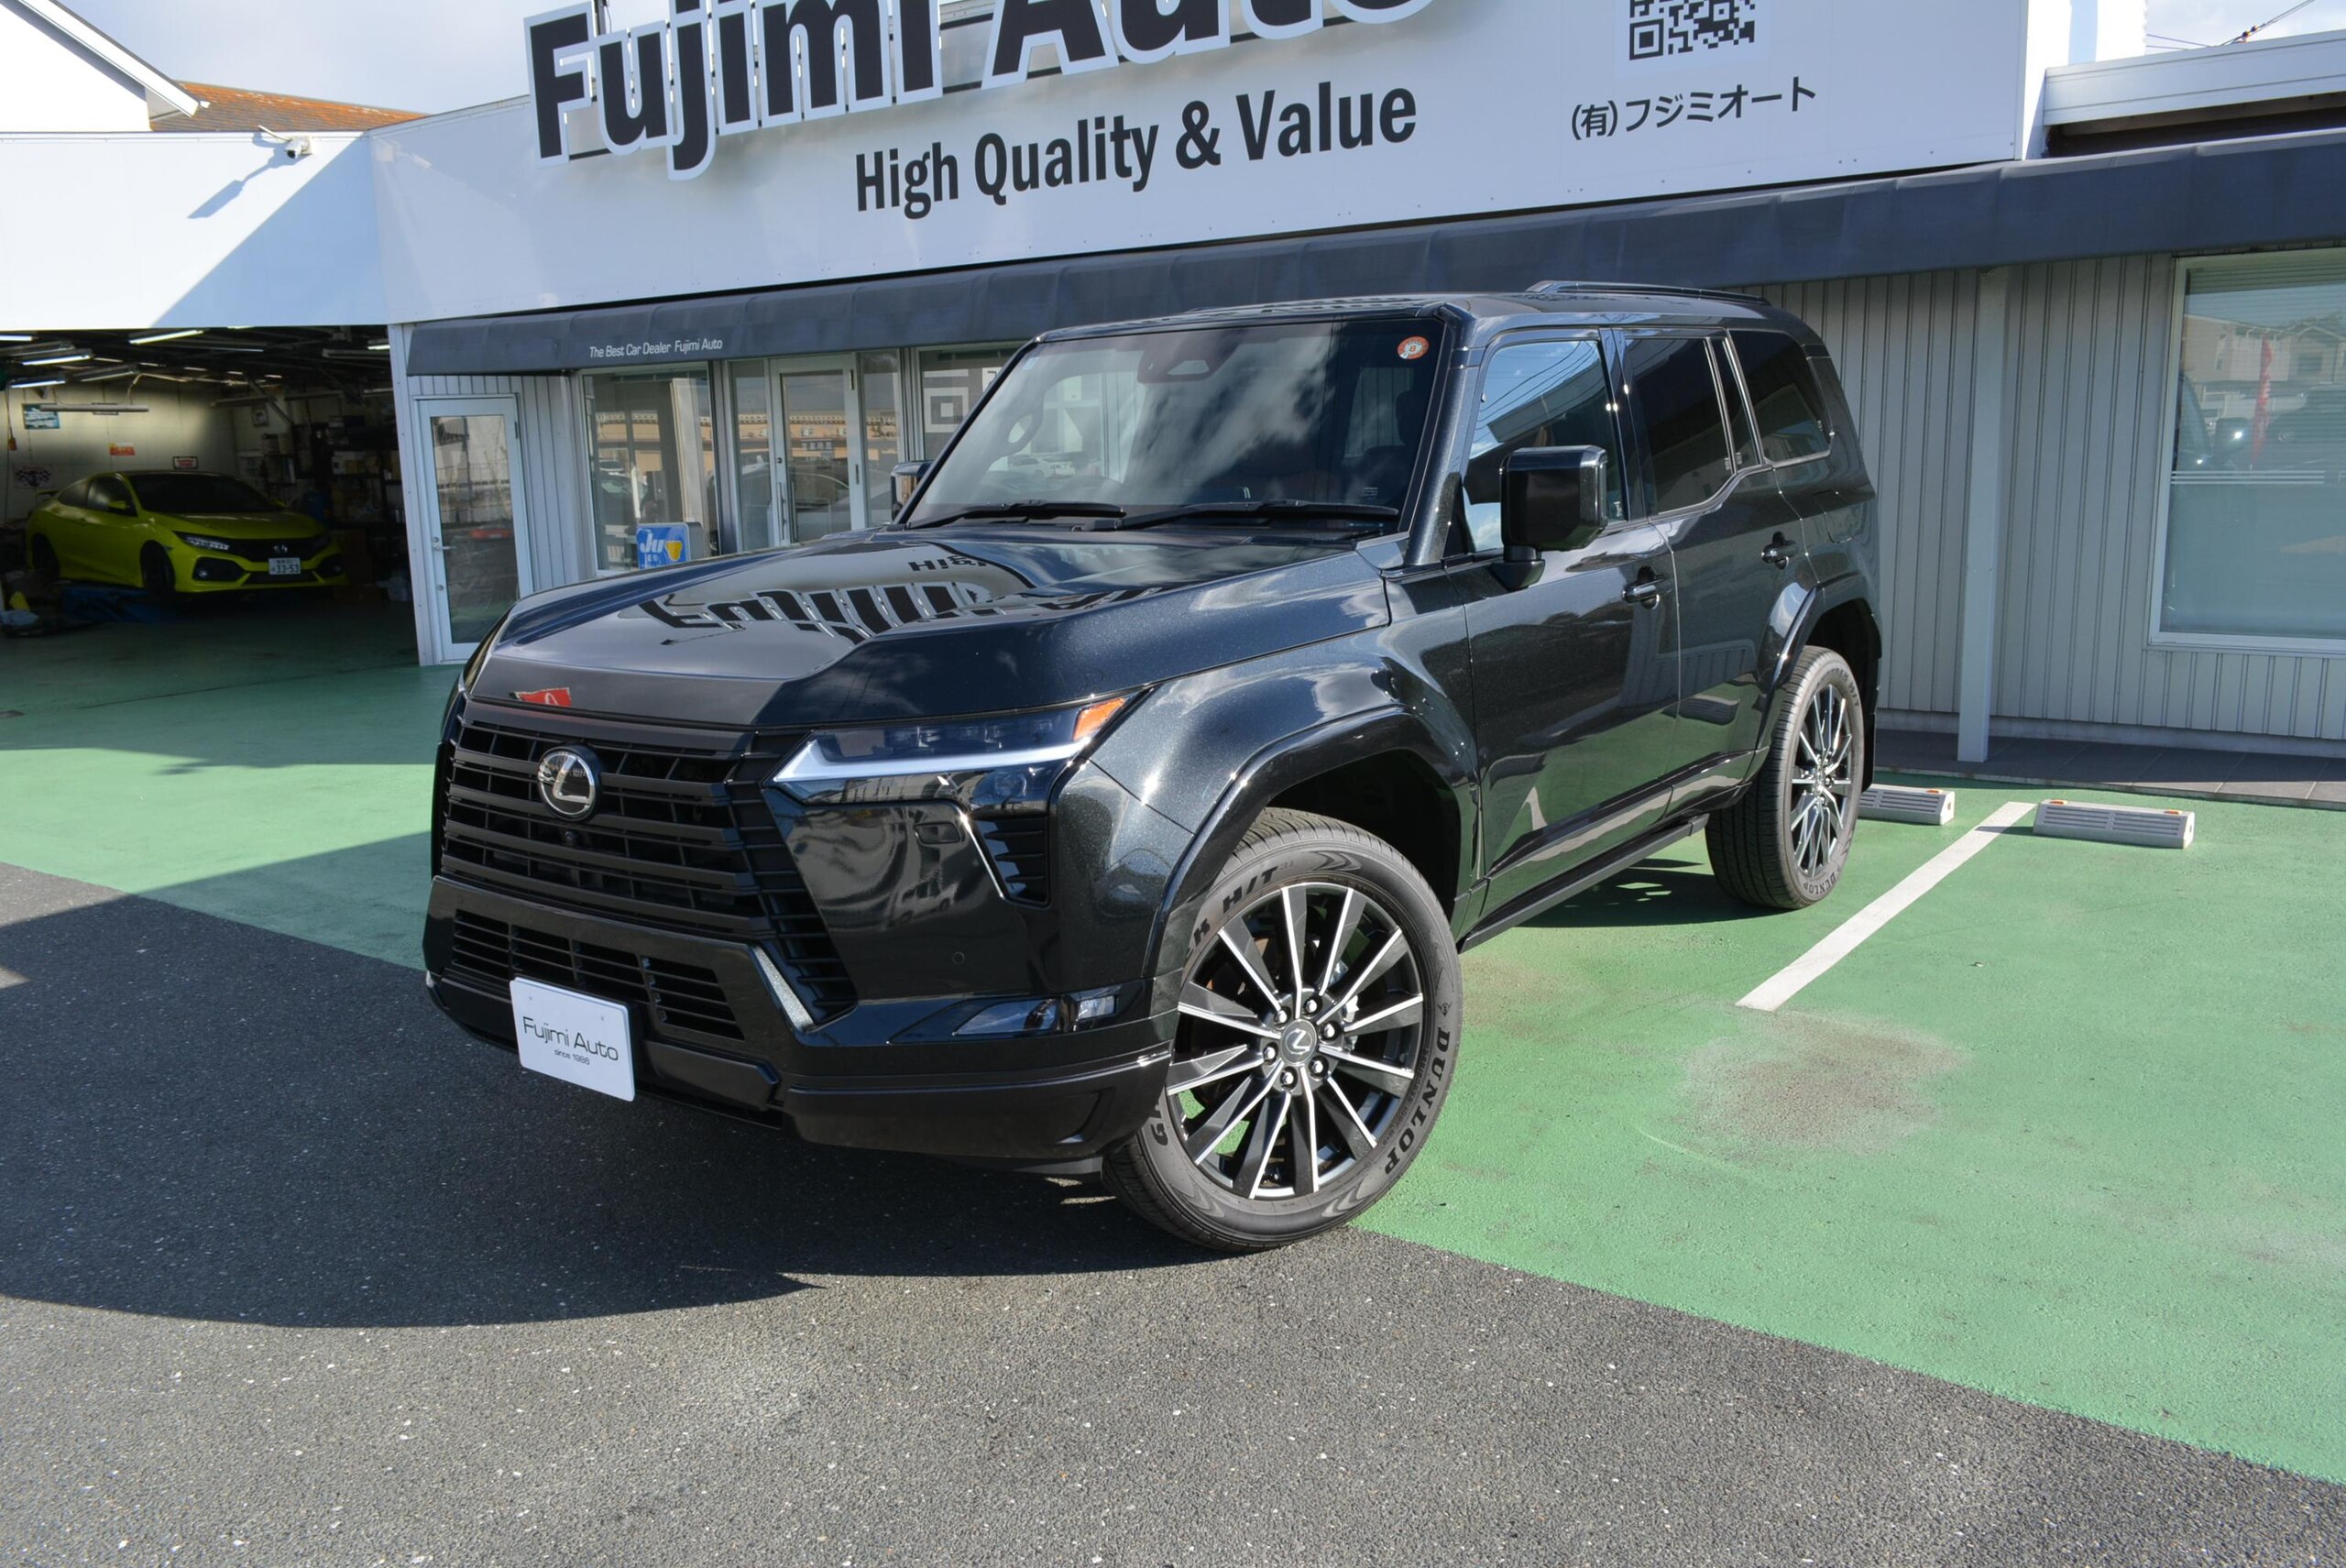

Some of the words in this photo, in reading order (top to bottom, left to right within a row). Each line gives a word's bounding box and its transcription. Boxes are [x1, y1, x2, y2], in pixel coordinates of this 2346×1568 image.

[1571, 75, 1816, 141] (有)フジミオート
[856, 141, 959, 220] High
[974, 115, 1159, 206] Quality
[1176, 100, 1221, 170] &
[1236, 81, 1417, 161] Value
[589, 345, 605, 358] The
[605, 345, 625, 357] Best
[626, 344, 641, 356] Car
[642, 341, 672, 355] Dealer
[674, 338, 700, 355] Fujimi
[701, 337, 723, 350] Auto
[276, 564, 300, 574] 33-53
[1222, 865, 1278, 915] H/T
[522, 1015, 570, 1047] Fujimi
[573, 1031, 619, 1061] Auto
[554, 1048, 571, 1059] since
[1384, 1026, 1451, 1176] DUNLOP
